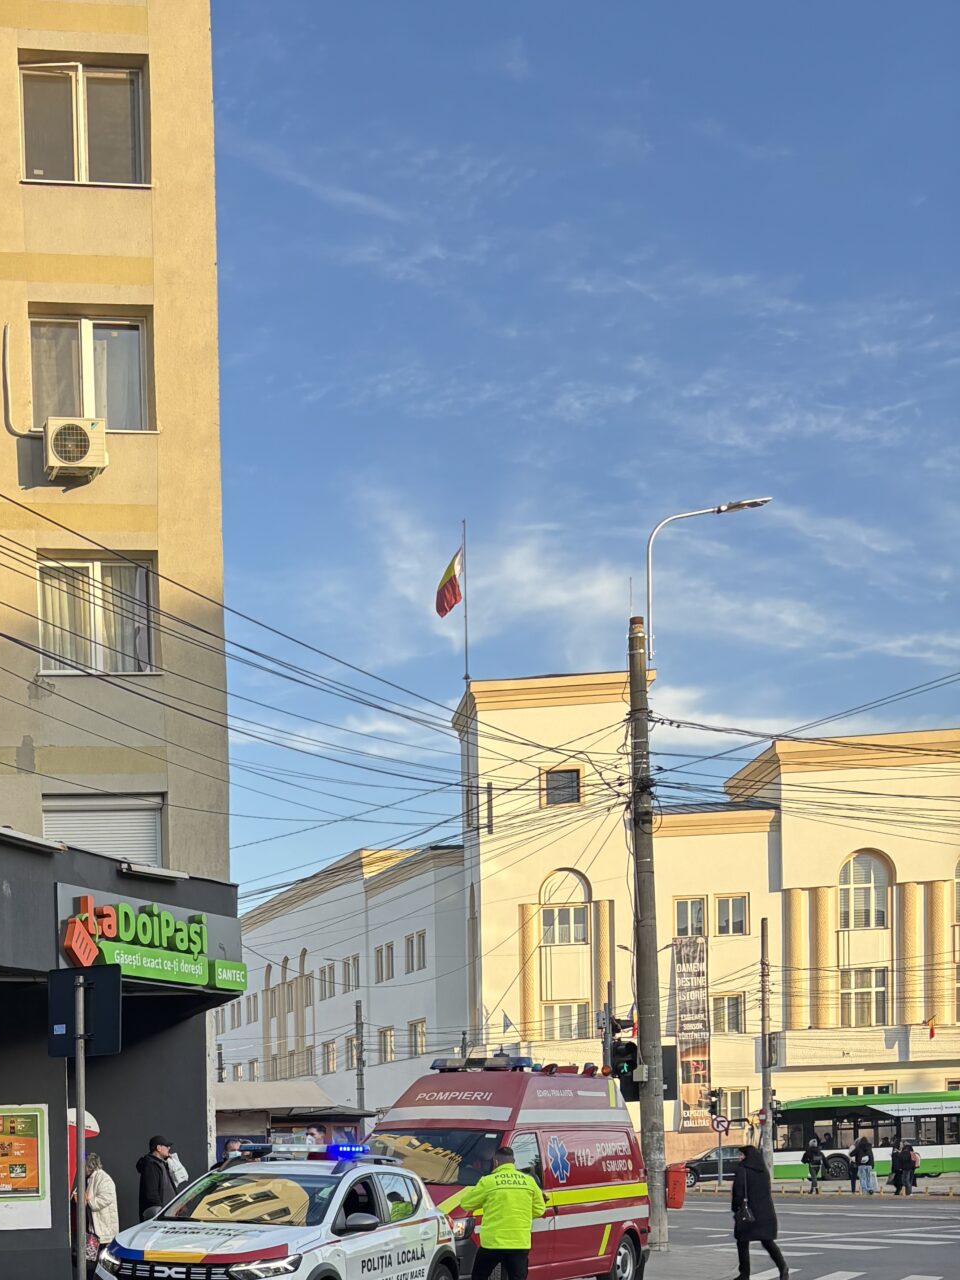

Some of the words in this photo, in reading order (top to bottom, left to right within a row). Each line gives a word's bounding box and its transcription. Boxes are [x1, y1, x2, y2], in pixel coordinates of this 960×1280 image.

[142, 957, 162, 969] exact
[217, 968, 245, 983] SANTEC
[416, 1091, 493, 1101] POMPIERII
[361, 1254, 393, 1274] POLIȚIA
[396, 1243, 426, 1266] LOCALĂ
[409, 1268, 425, 1279] MARE
